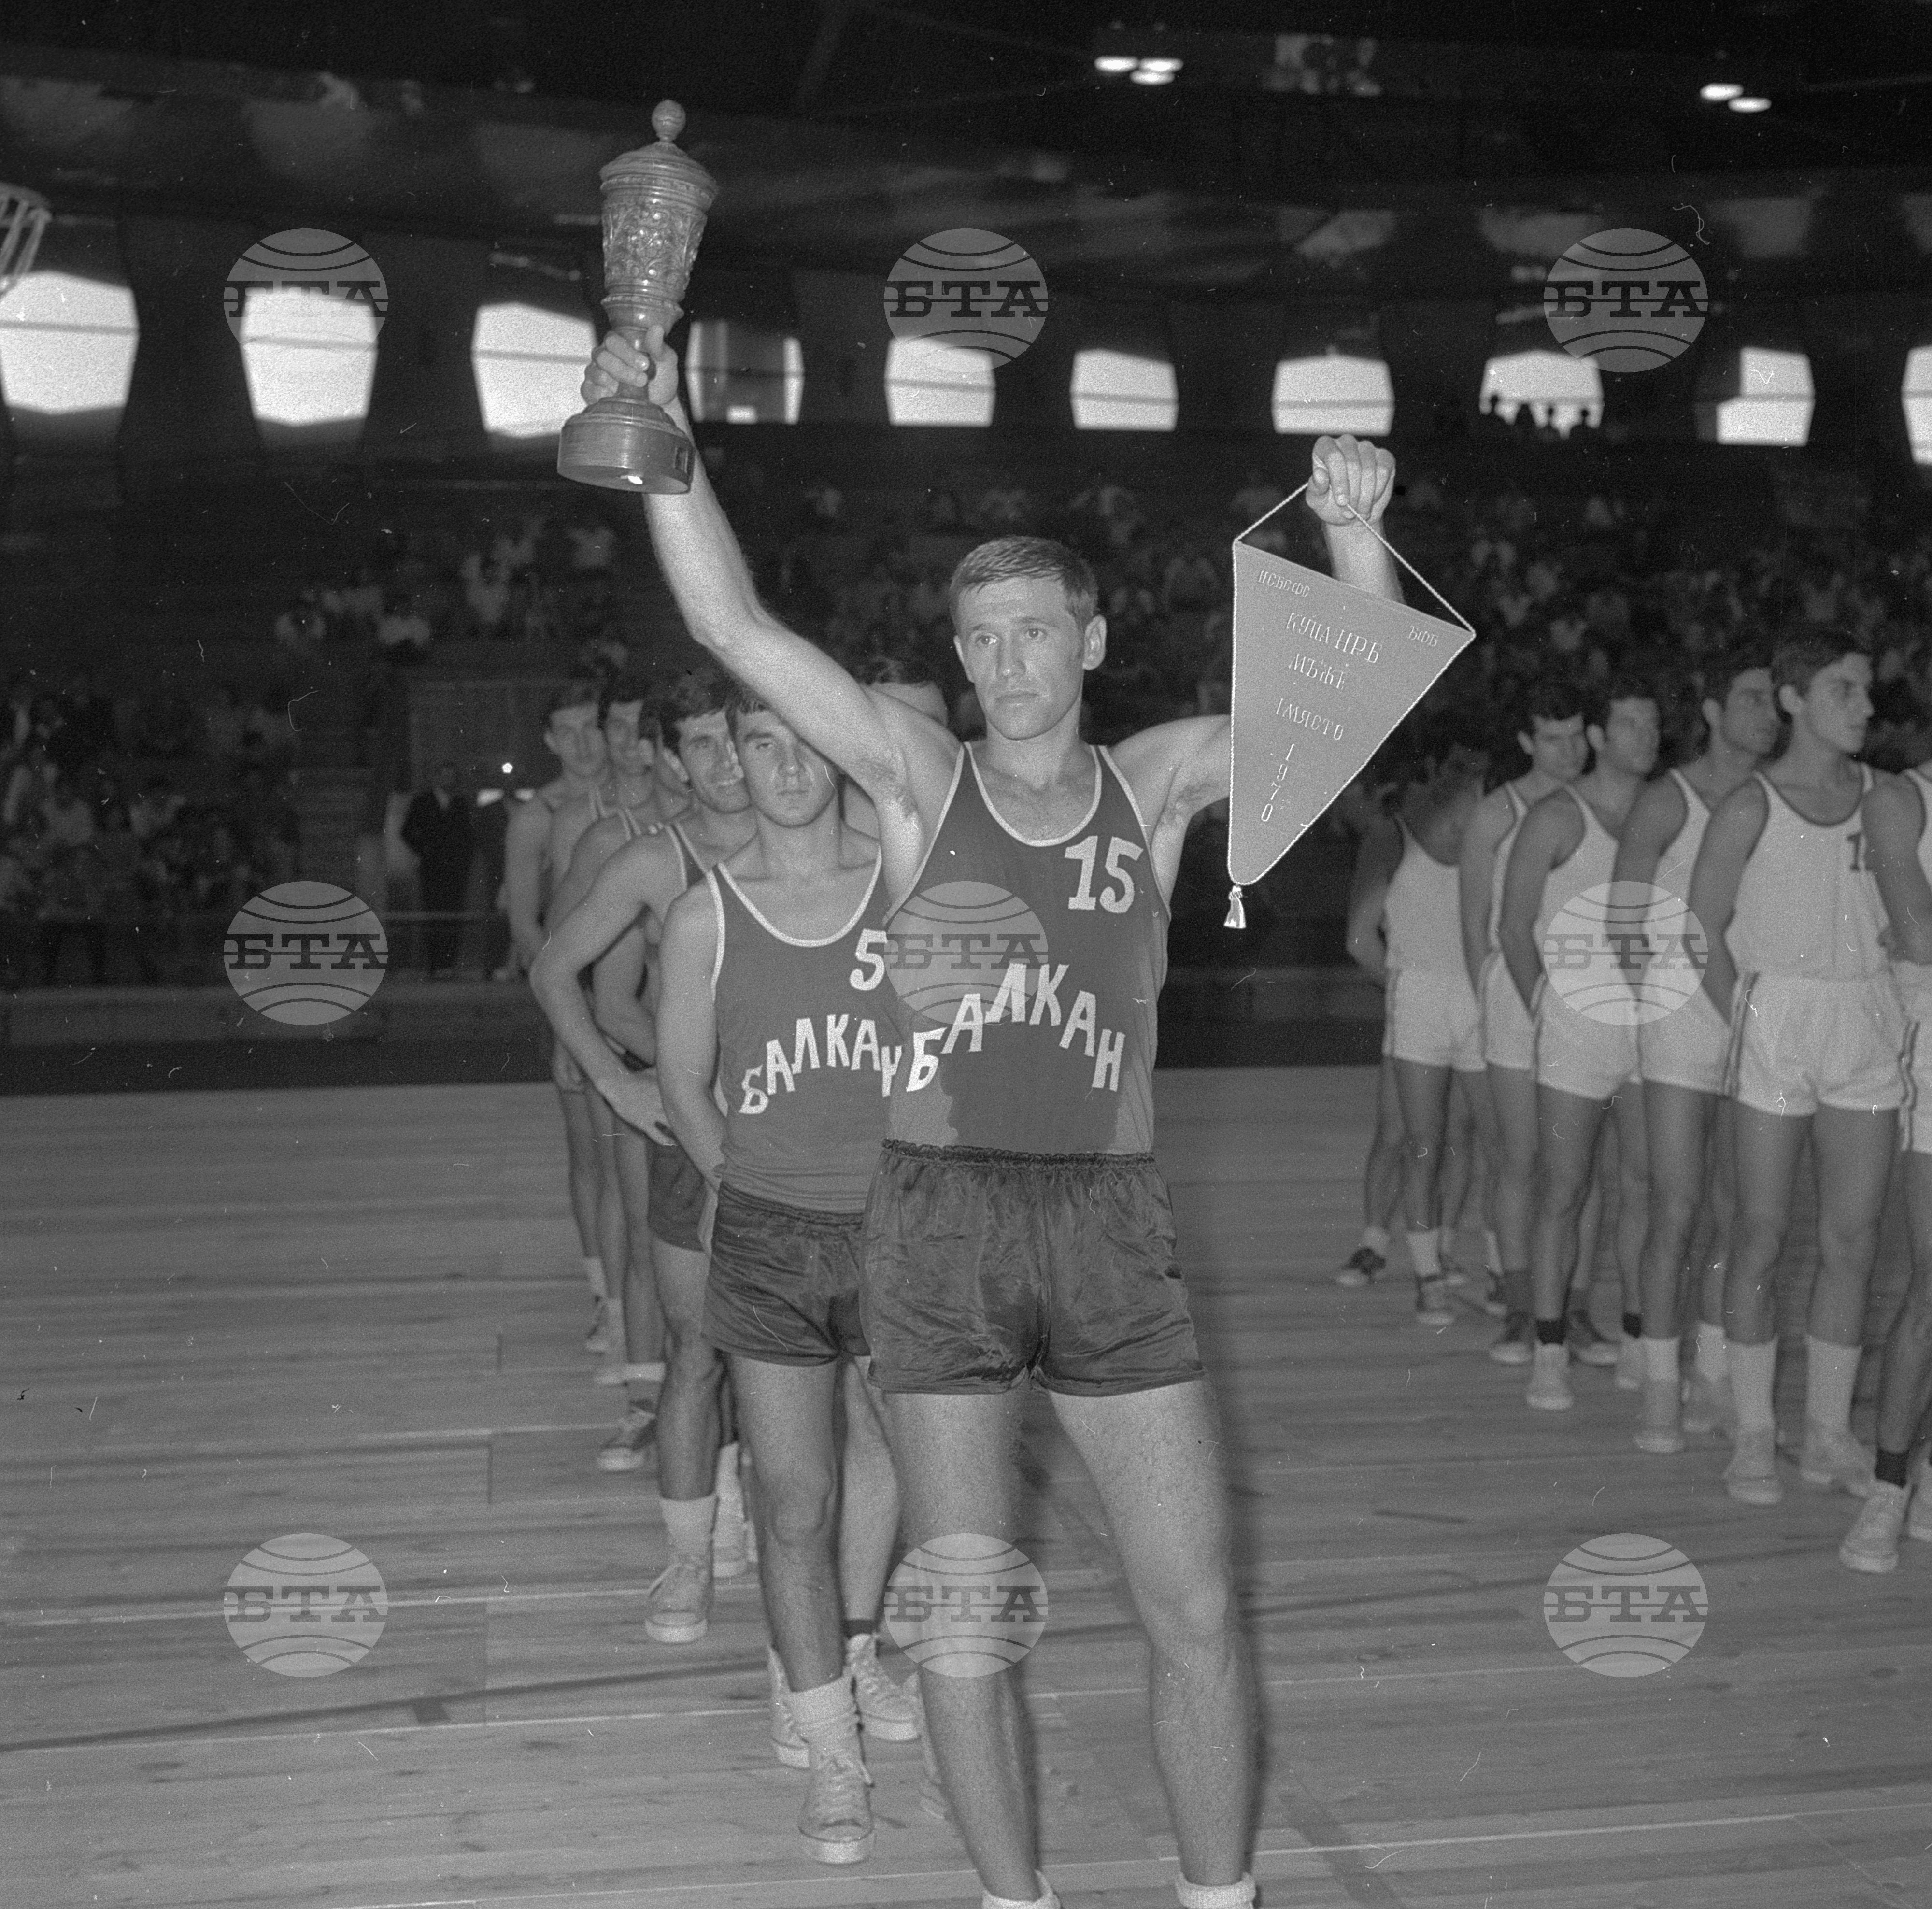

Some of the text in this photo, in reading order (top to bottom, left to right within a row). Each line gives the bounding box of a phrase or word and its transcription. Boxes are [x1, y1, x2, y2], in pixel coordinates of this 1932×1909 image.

[1286, 612, 1383, 664] КУПА НРБ
[1288, 653, 1347, 689] МЪЖЕ
[1064, 835, 1143, 914] 15
[850, 928, 888, 991] 5
[906, 963, 1126, 1093] БАЛКАН
